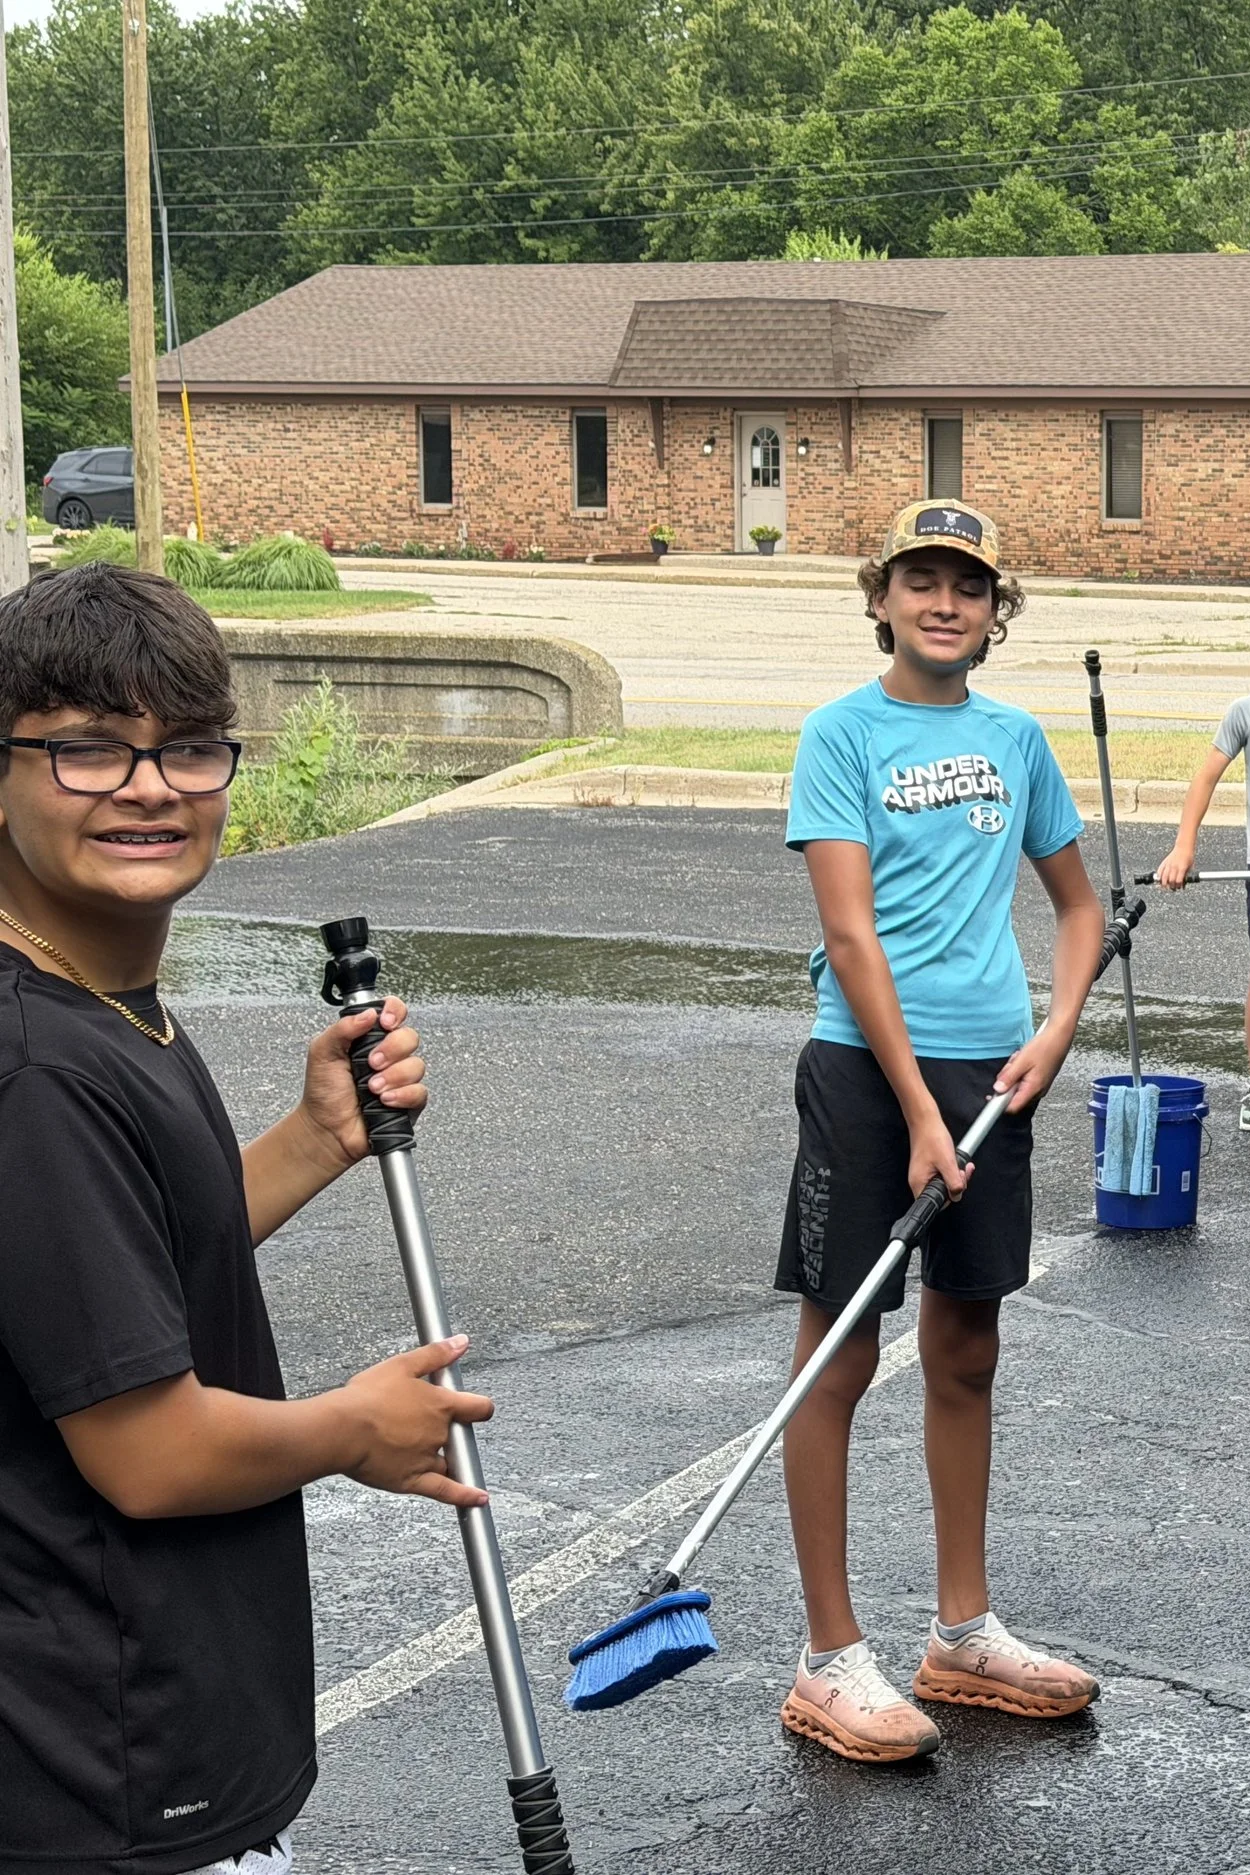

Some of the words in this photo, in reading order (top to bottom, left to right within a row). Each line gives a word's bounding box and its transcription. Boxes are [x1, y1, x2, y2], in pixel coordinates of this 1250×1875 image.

[943, 526, 978, 543] PATROL
[890, 754, 994, 787] UNDER
[882, 774, 1008, 811] ARMOUR
[809, 1193, 830, 1290] UNDER
[163, 1800, 209, 1819] DriWorks
